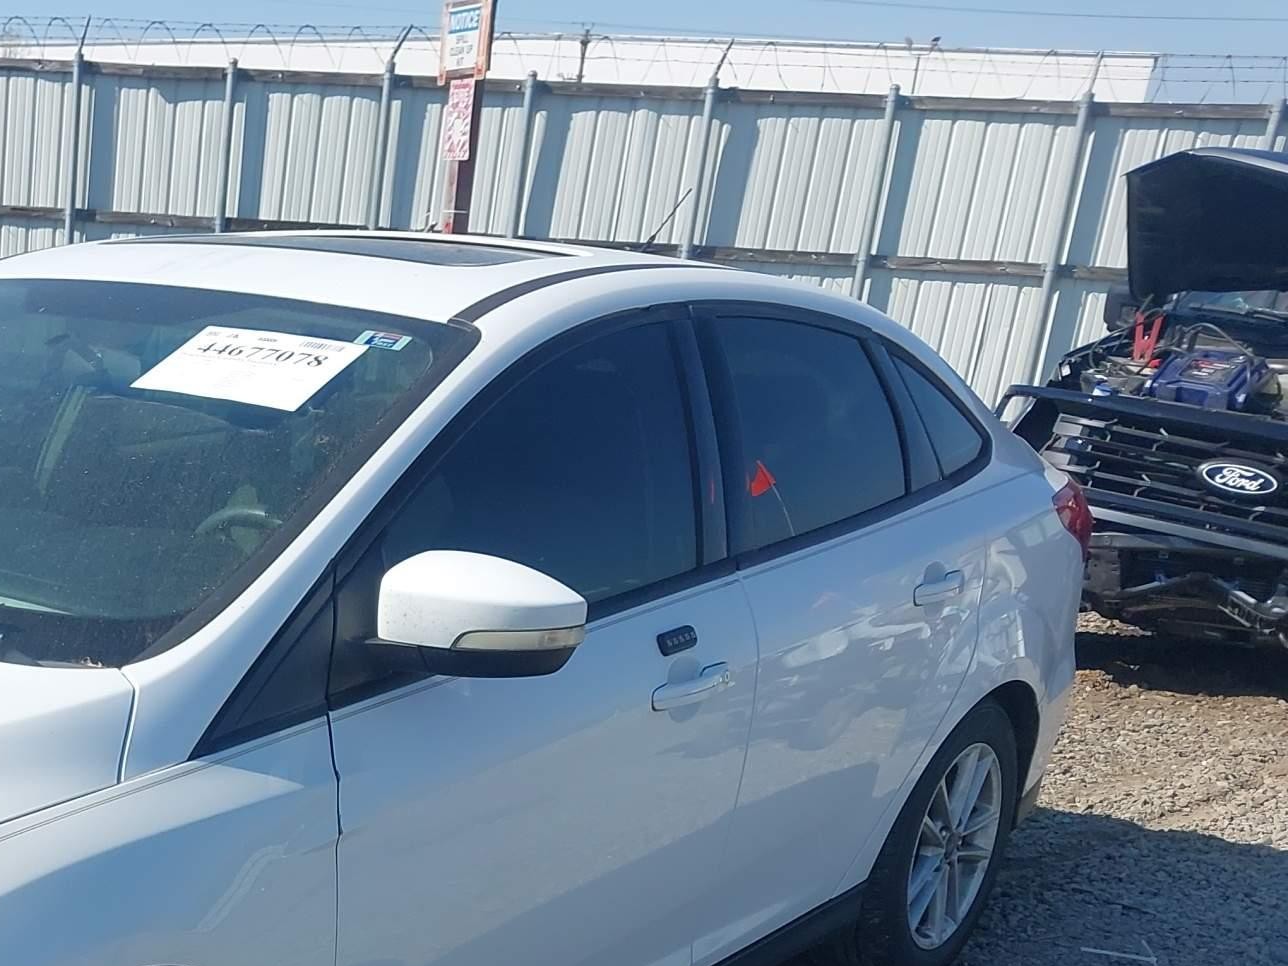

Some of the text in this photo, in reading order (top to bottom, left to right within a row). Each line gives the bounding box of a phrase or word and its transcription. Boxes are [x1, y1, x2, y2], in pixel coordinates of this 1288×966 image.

[450, 9, 480, 31] NOTICE
[197, 342, 328, 368] 44677078
[1215, 467, 1265, 491] Ford
